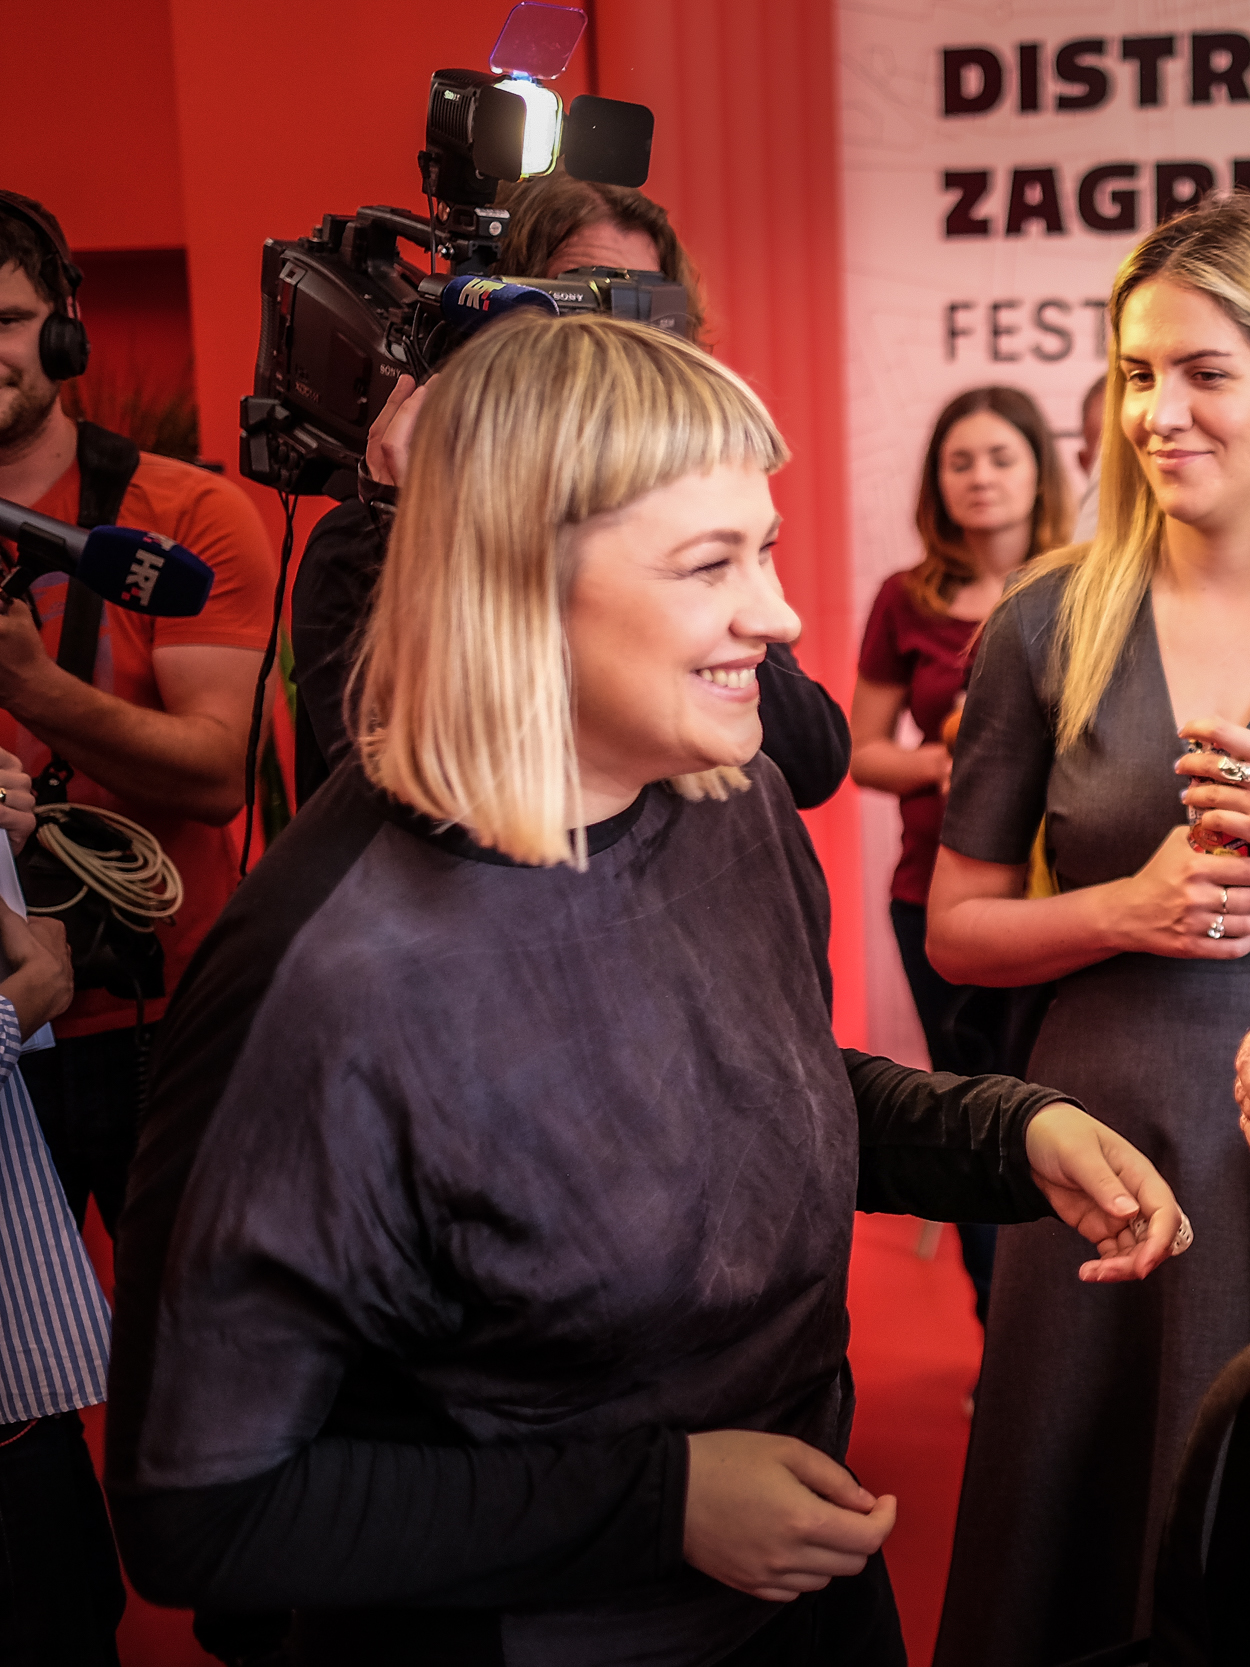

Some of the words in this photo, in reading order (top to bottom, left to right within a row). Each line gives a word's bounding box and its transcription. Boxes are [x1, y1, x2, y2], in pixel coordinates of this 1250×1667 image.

[458, 277, 507, 311] HRT
[946, 299, 1109, 362] FEST
[379, 363, 402, 378] SONY
[124, 547, 166, 607] HRT
